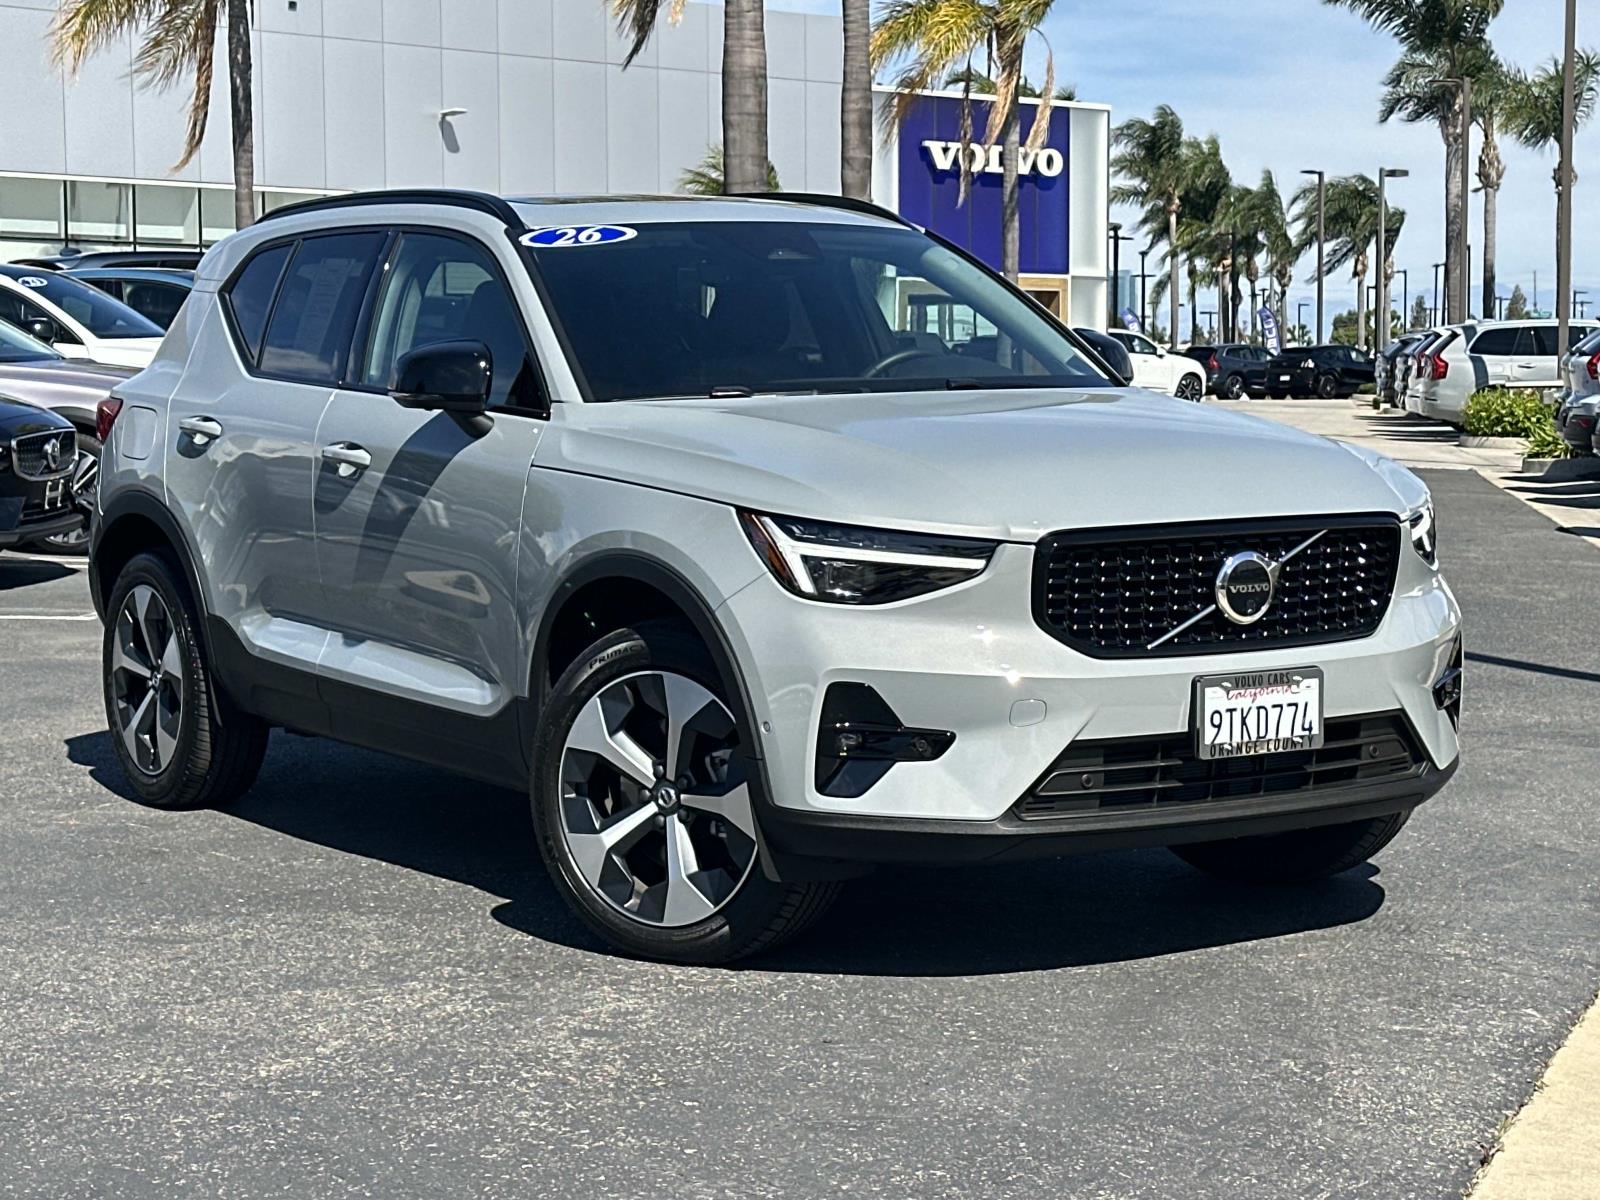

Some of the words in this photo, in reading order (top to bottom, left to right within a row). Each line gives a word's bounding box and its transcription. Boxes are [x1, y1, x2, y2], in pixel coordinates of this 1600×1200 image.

[551, 226, 602, 246] 26
[1228, 583, 1270, 594] VOLVO
[1234, 674, 1264, 688] VOLVO
[1267, 672, 1291, 685] CARS
[1210, 701, 1313, 745] 9TKD774
